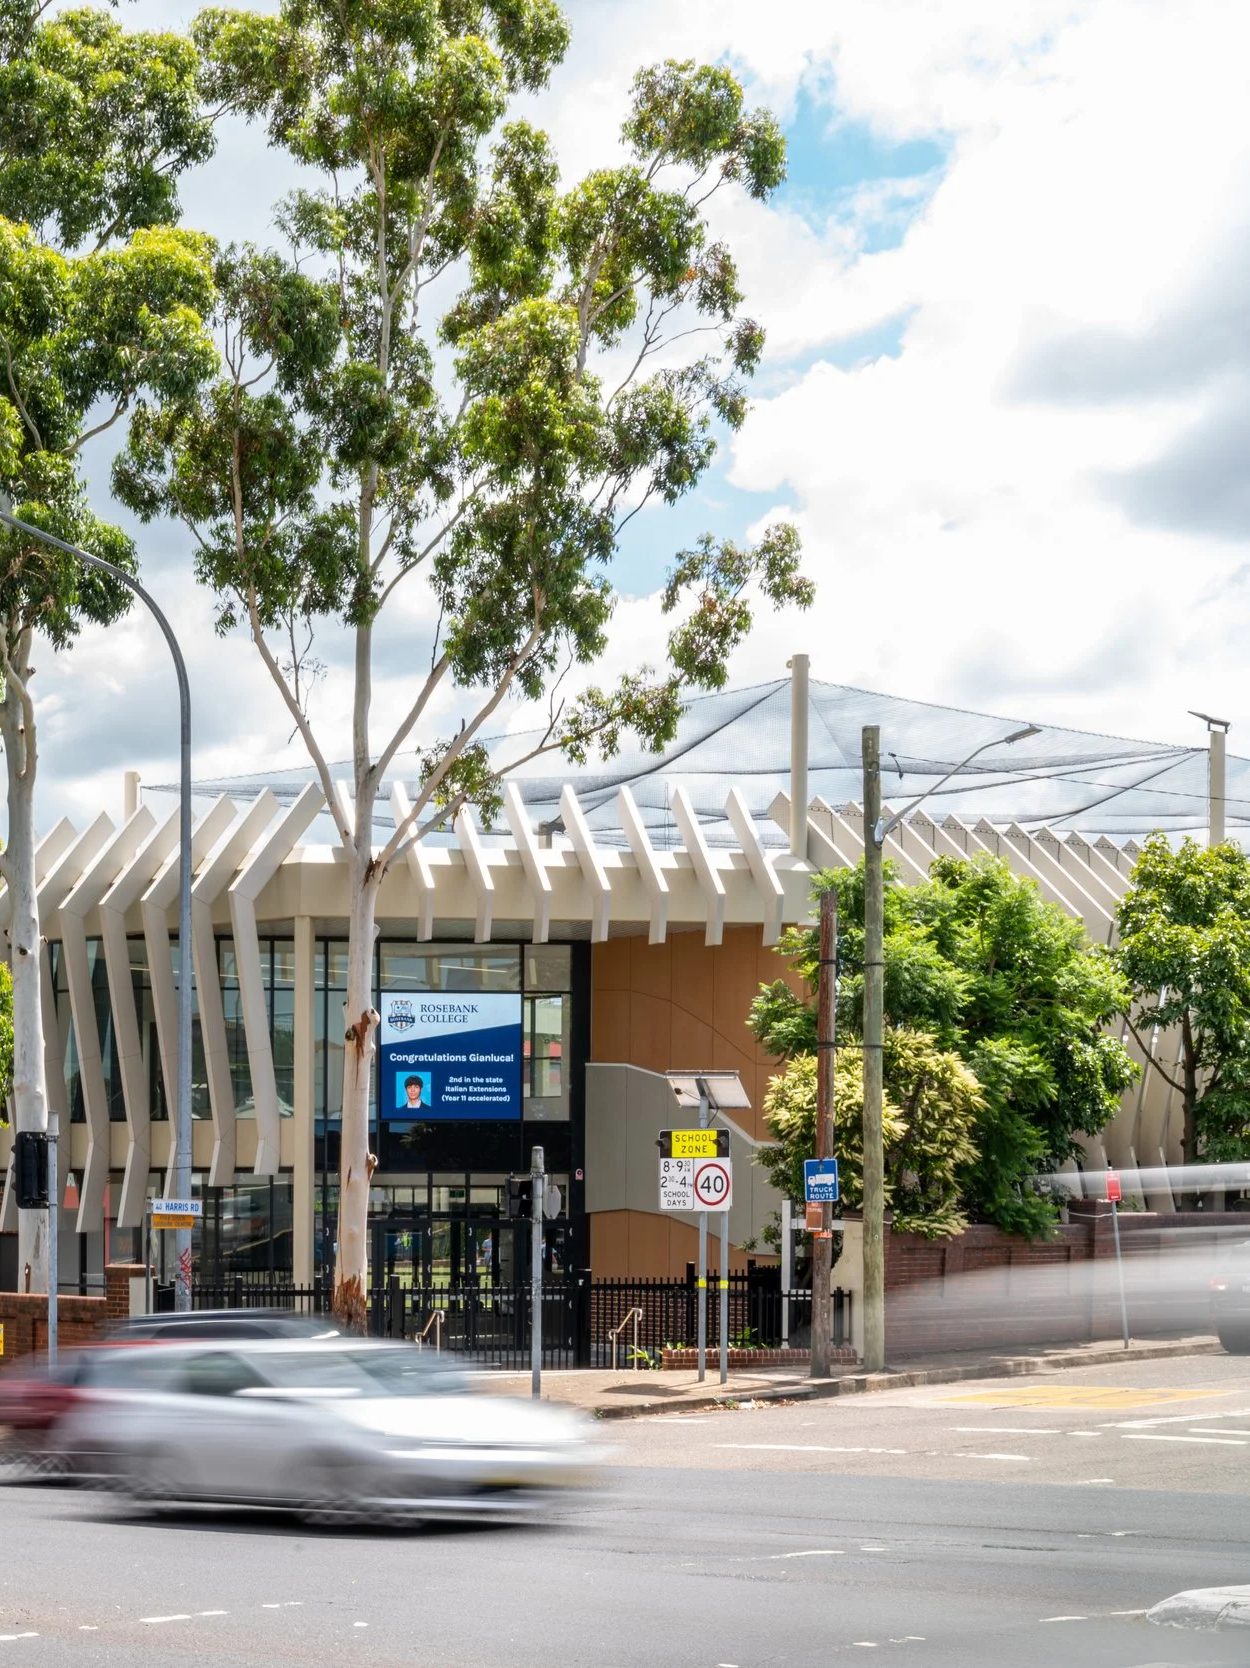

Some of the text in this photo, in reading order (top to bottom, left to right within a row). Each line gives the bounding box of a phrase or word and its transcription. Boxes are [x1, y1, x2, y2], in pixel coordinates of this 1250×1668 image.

[420, 1004, 478, 1013] ROSEBANK
[420, 1014, 468, 1023] COLLEGE
[390, 1053, 514, 1063] Congratulations Gianluca!
[441, 1095, 460, 1103] (Year
[468, 1095, 511, 1103] accelerated)
[675, 1134, 712, 1142] SCHOOL
[681, 1145, 707, 1153] ZONE
[700, 1175, 724, 1193] 40
[165, 1202, 189, 1211] HARRIS
[190, 1203, 199, 1212] RD
[667, 1199, 687, 1207] DAYS
